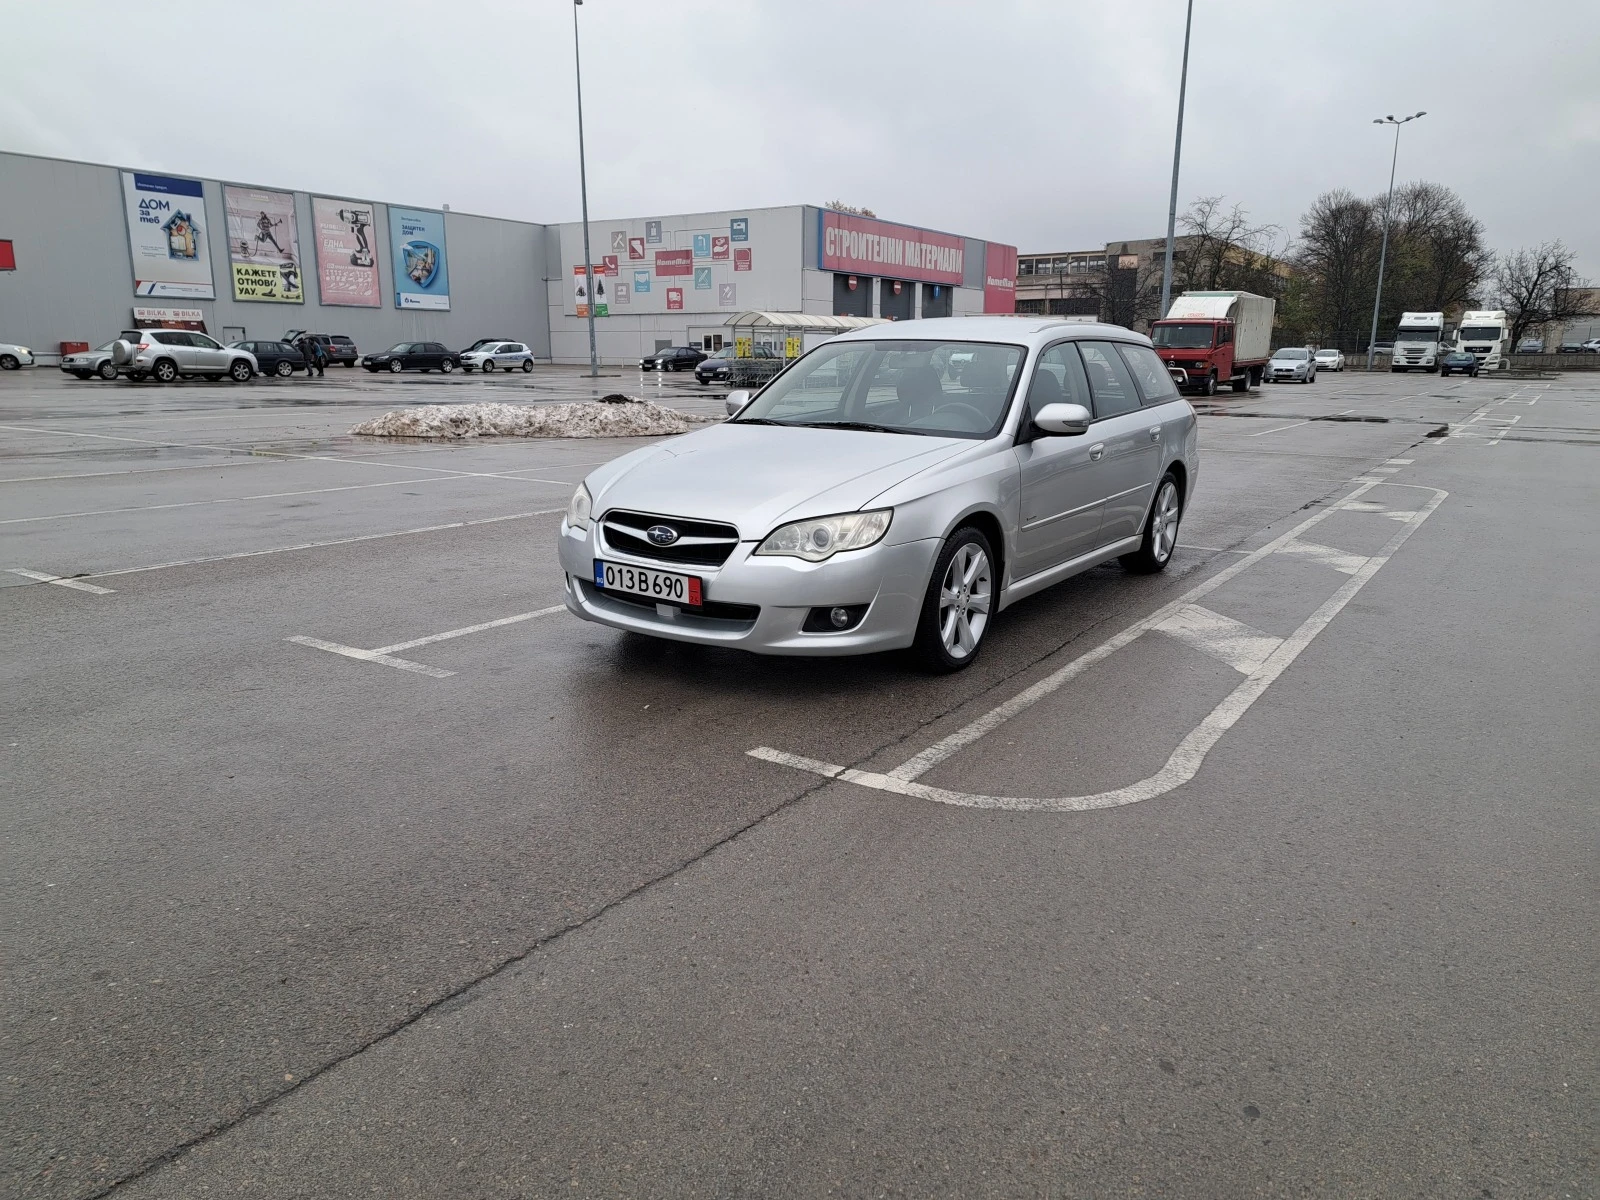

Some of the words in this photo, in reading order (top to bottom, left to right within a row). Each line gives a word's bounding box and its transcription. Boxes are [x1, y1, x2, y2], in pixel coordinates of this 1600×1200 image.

[139, 198, 170, 211] ДОМ
[140, 216, 160, 224] теб
[324, 239, 344, 249] ЕДНА
[825, 226, 903, 266] СТРОИТЕЛНИ
[905, 240, 963, 274] МАТЕРИАЛИ
[236, 267, 277, 279] КАЖЕТЕ
[238, 287, 258, 296] УАУ.
[147, 309, 167, 317] BILKA
[181, 310, 201, 318] BILKA
[606, 566, 684, 599] 013B690
